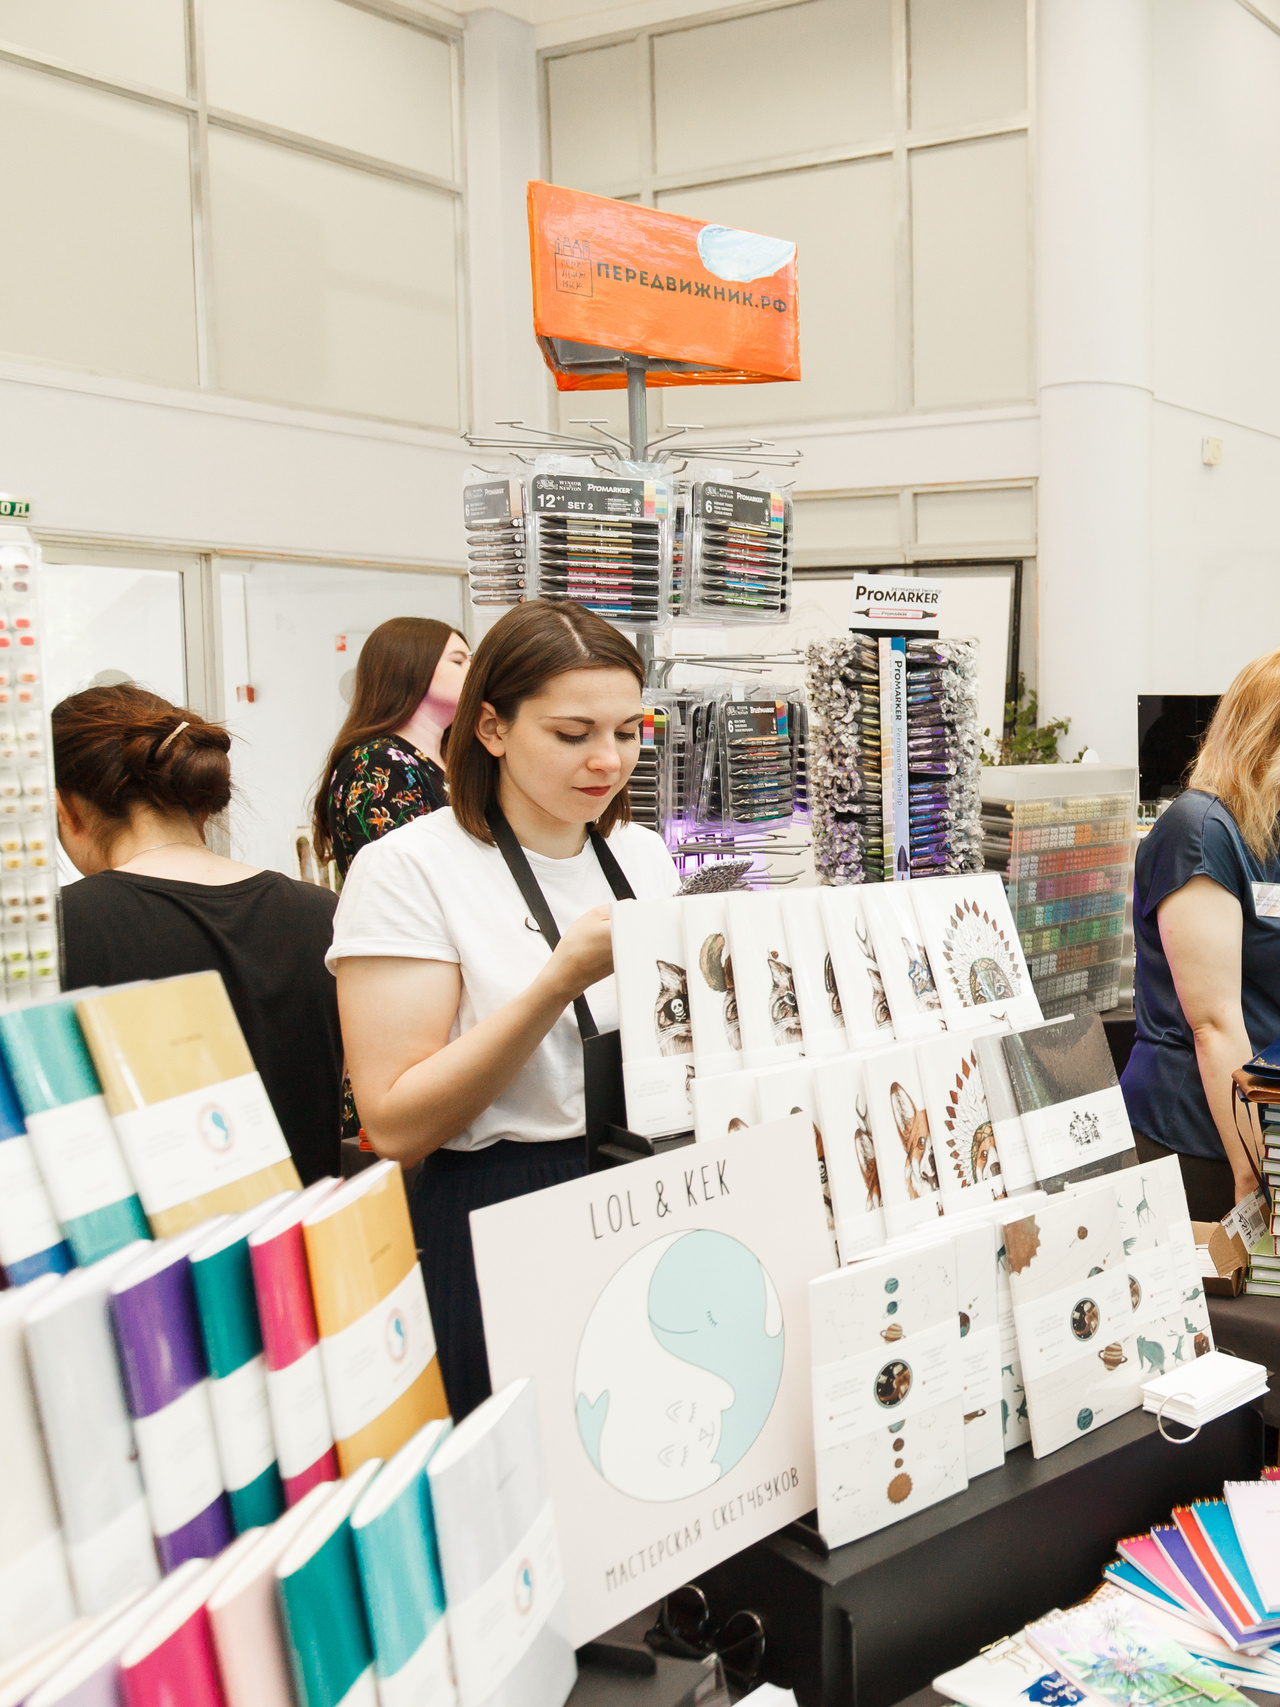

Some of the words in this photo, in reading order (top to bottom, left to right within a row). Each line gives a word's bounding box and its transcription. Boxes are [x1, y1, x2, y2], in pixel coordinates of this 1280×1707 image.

[596, 261, 787, 313] ПЕРЕДВИЖНИК.РФ
[465, 503, 471, 517] 6
[567, 501, 586, 510] SET
[587, 502, 594, 511] 2
[705, 499, 713, 514] 6
[727, 719, 734, 733] 6
[895, 727, 903, 774] Permanent
[590, 1190, 641, 1240] LOL
[656, 1180, 672, 1218] &
[684, 1159, 730, 1207] KEK
[605, 1518, 703, 1593] МАСТЕРСКАЯ
[712, 1467, 800, 1532] СКЕТЧБУКОВ
